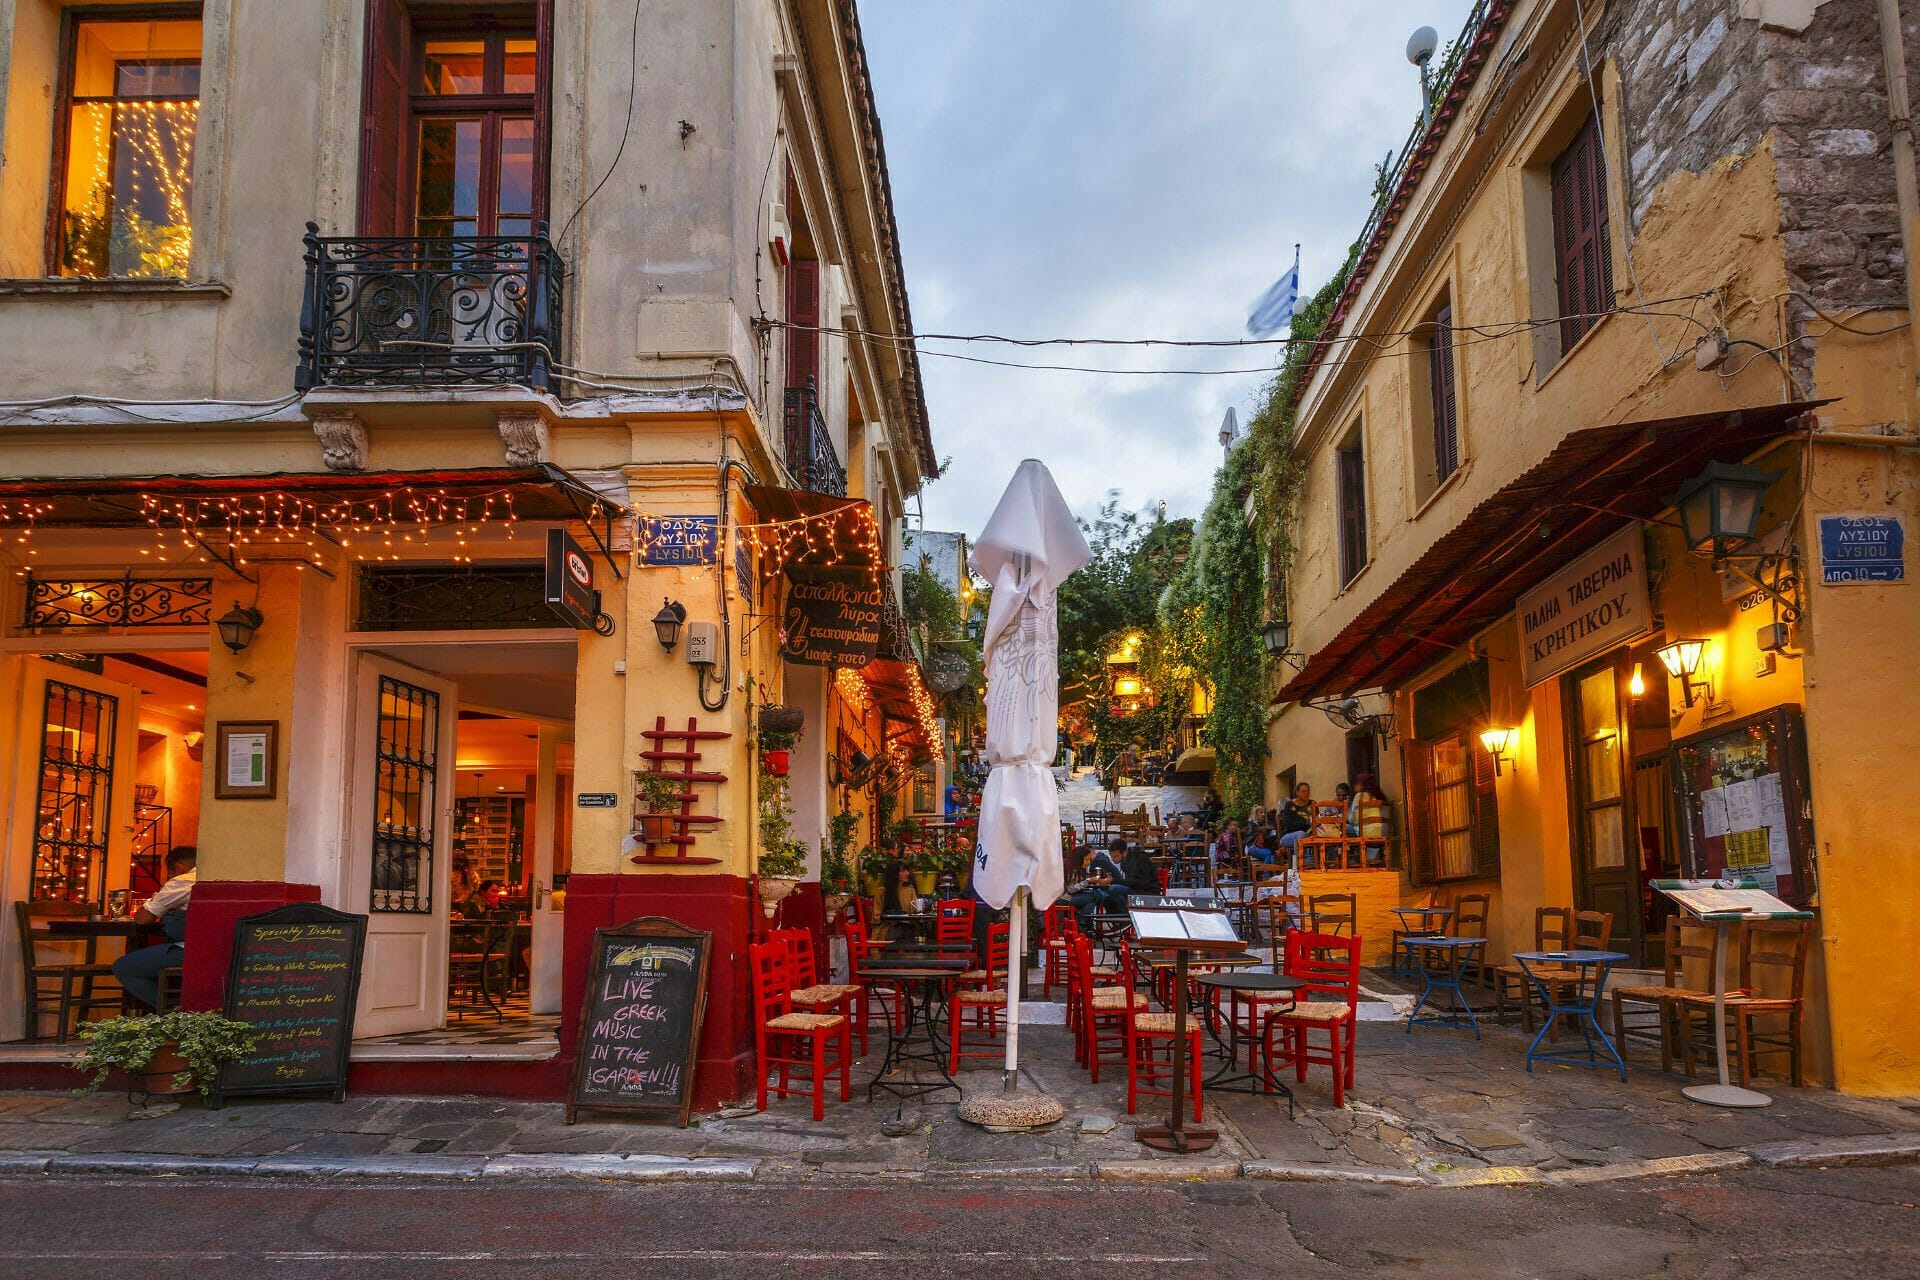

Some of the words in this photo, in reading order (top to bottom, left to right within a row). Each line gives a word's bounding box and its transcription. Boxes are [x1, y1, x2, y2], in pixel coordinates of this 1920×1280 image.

[661, 520, 704, 530] ΟΔΟΣ
[659, 533, 706, 544] ΛΥΣΙΟΥ
[1840, 530, 1889, 541] ΛΥΣΙΟΥ
[656, 548, 702, 560] LYSIOU
[1837, 546, 1887, 557] LYSIOU
[1567, 552, 1632, 607] ΤΑΒΕΡΝΑ
[691, 636, 706, 645] 253
[691, 650, 701, 658] 23
[1159, 898, 1194, 907] ΑΛΦΑ
[305, 925, 342, 936] Dishes
[603, 974, 655, 1002] LIVE
[613, 1003, 667, 1022] GREEK
[592, 1019, 642, 1040] MUSIC
[590, 1044, 609, 1060] IN
[613, 1046, 650, 1063] THE
